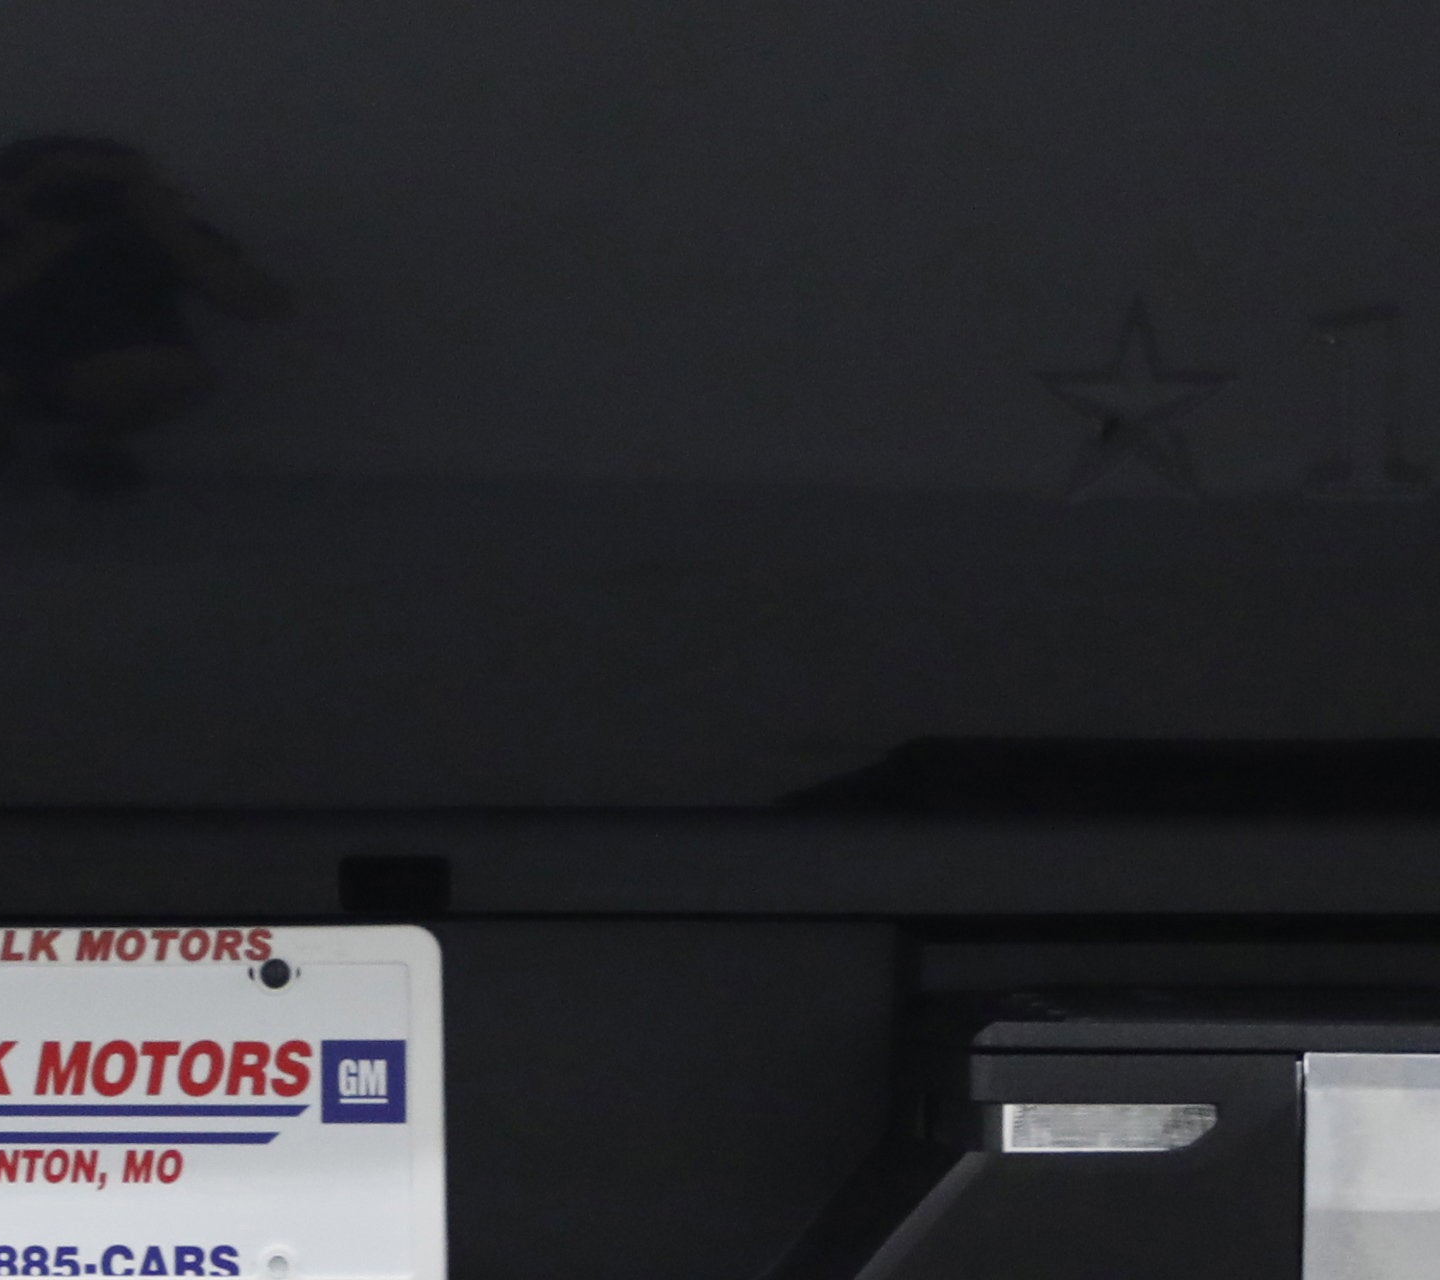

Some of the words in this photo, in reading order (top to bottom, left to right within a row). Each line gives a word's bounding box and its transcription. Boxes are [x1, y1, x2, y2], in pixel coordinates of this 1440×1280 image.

[75, 928, 273, 962] MOTORS
[33, 1039, 313, 1098] MOTORS
[337, 1059, 388, 1096] GM
[121, 1148, 184, 1184] MO
